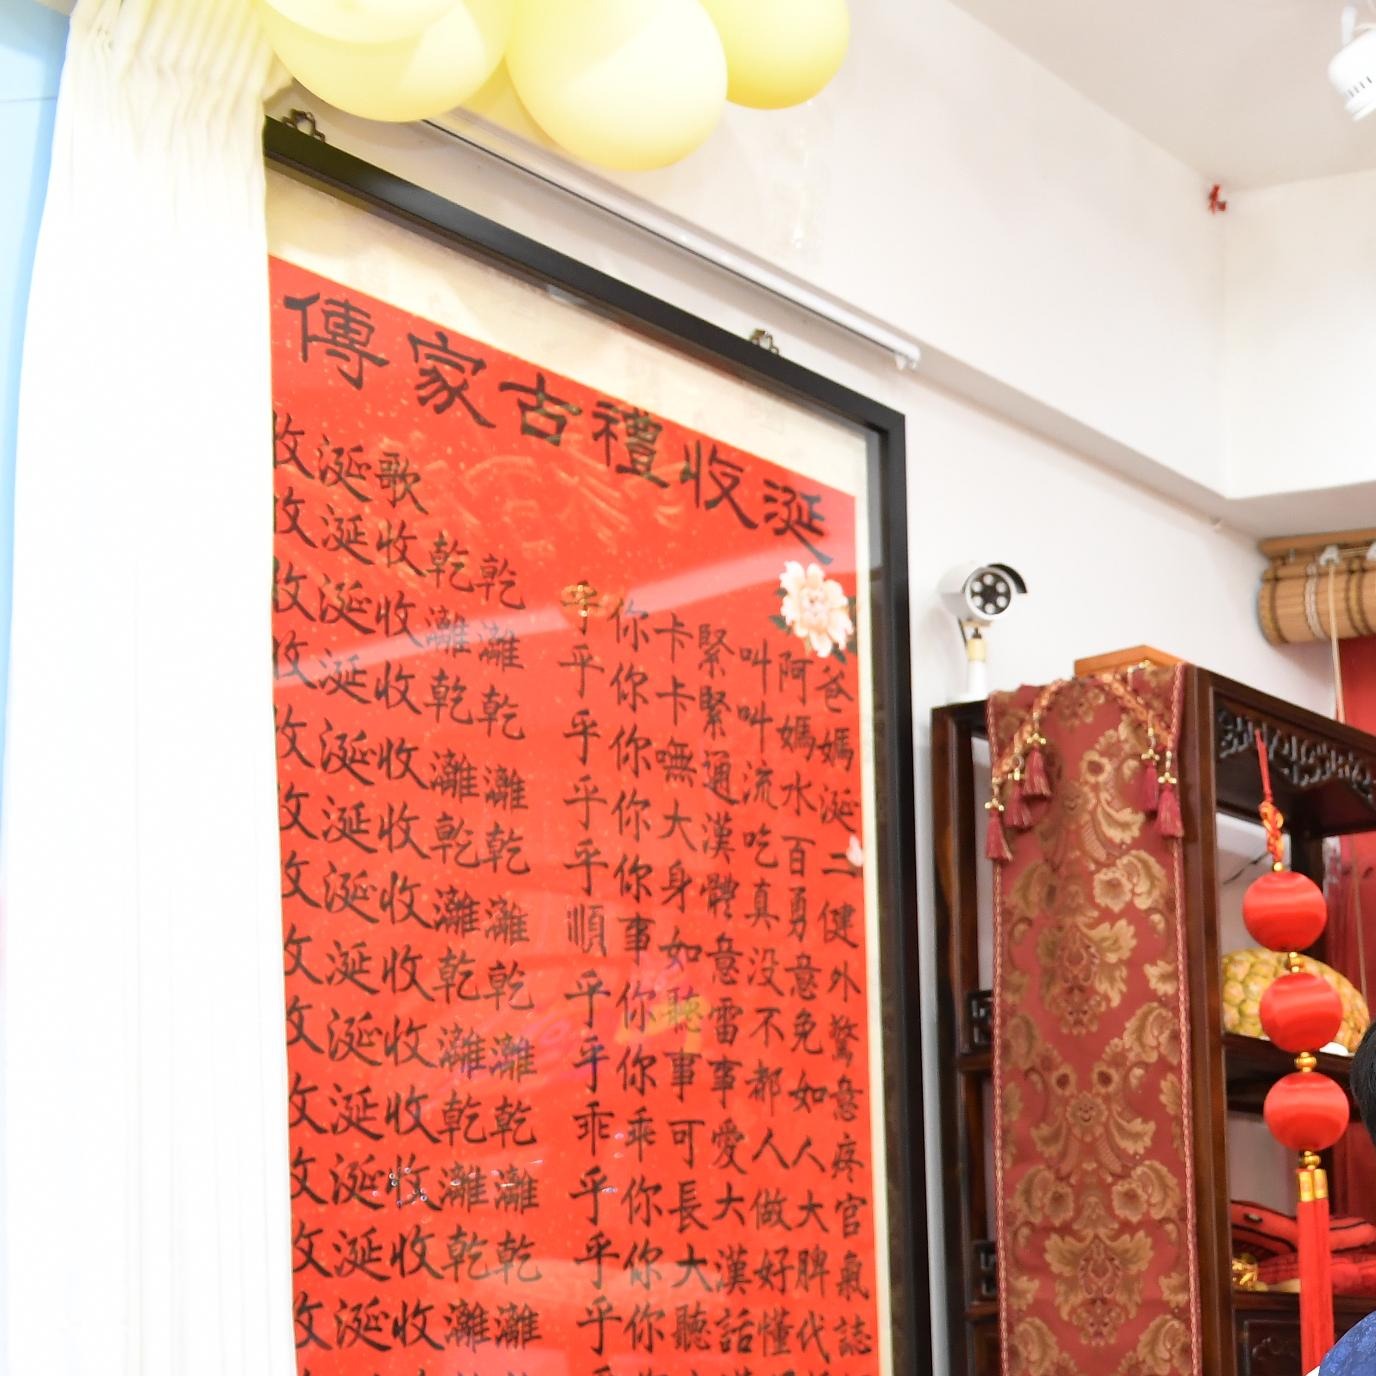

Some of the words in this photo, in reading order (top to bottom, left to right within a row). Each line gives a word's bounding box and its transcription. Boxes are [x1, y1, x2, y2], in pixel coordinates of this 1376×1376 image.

[283, 291, 834, 566] 傳家古禮收涎
[574, 1036, 862, 1121] 乎你事事都如意
[570, 1166, 866, 1237] 乎你長大做大官
